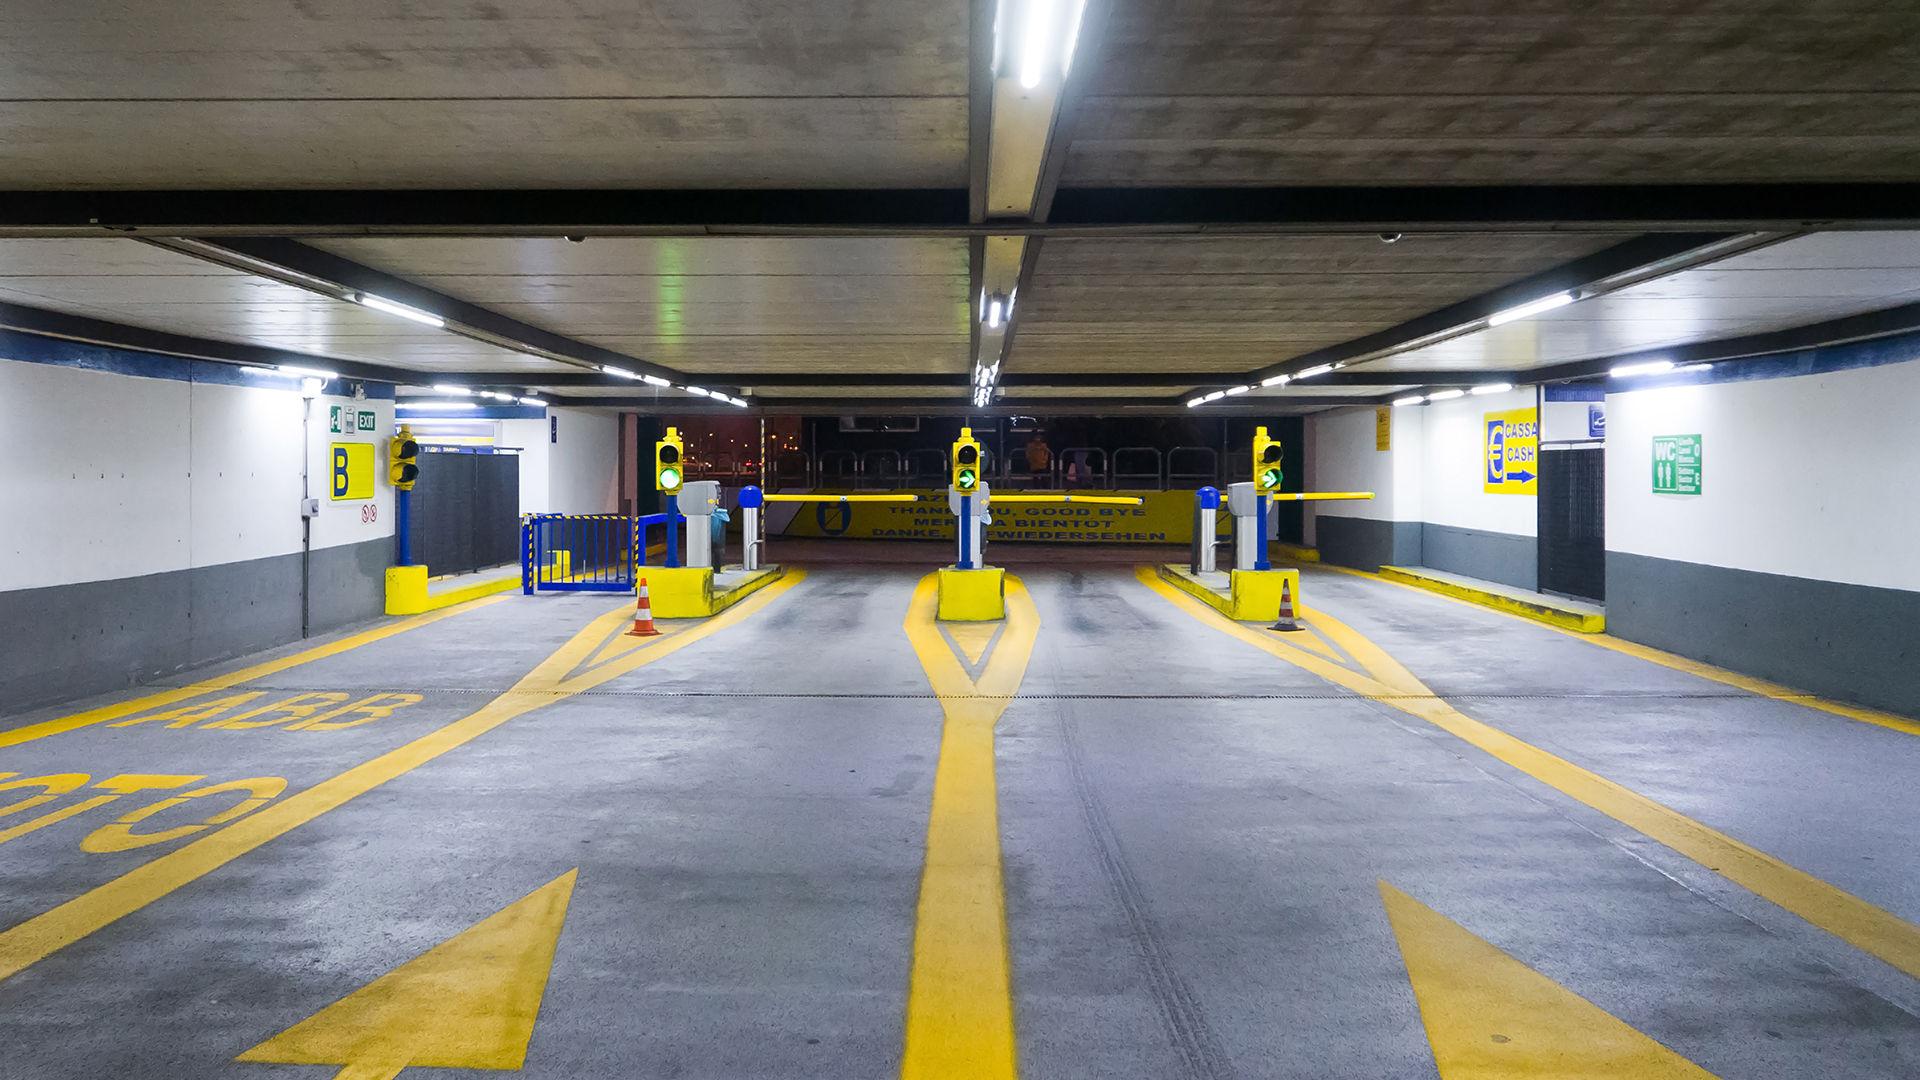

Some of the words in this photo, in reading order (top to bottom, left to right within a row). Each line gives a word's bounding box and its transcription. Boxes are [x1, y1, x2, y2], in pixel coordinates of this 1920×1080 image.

[360, 415, 374, 428] EXIT
[1505, 422, 1538, 438] CASSA
[1507, 446, 1535, 462] CASH
[1655, 442, 1676, 461] WC
[334, 448, 349, 497] B
[1025, 508, 1091, 516] GOOD
[1099, 508, 1146, 517] BYE
[914, 518, 955, 526] MER
[1015, 520, 1114, 528] BIENTOT
[872, 528, 947, 538] DANKE,
[106, 691, 424, 731] ABB
